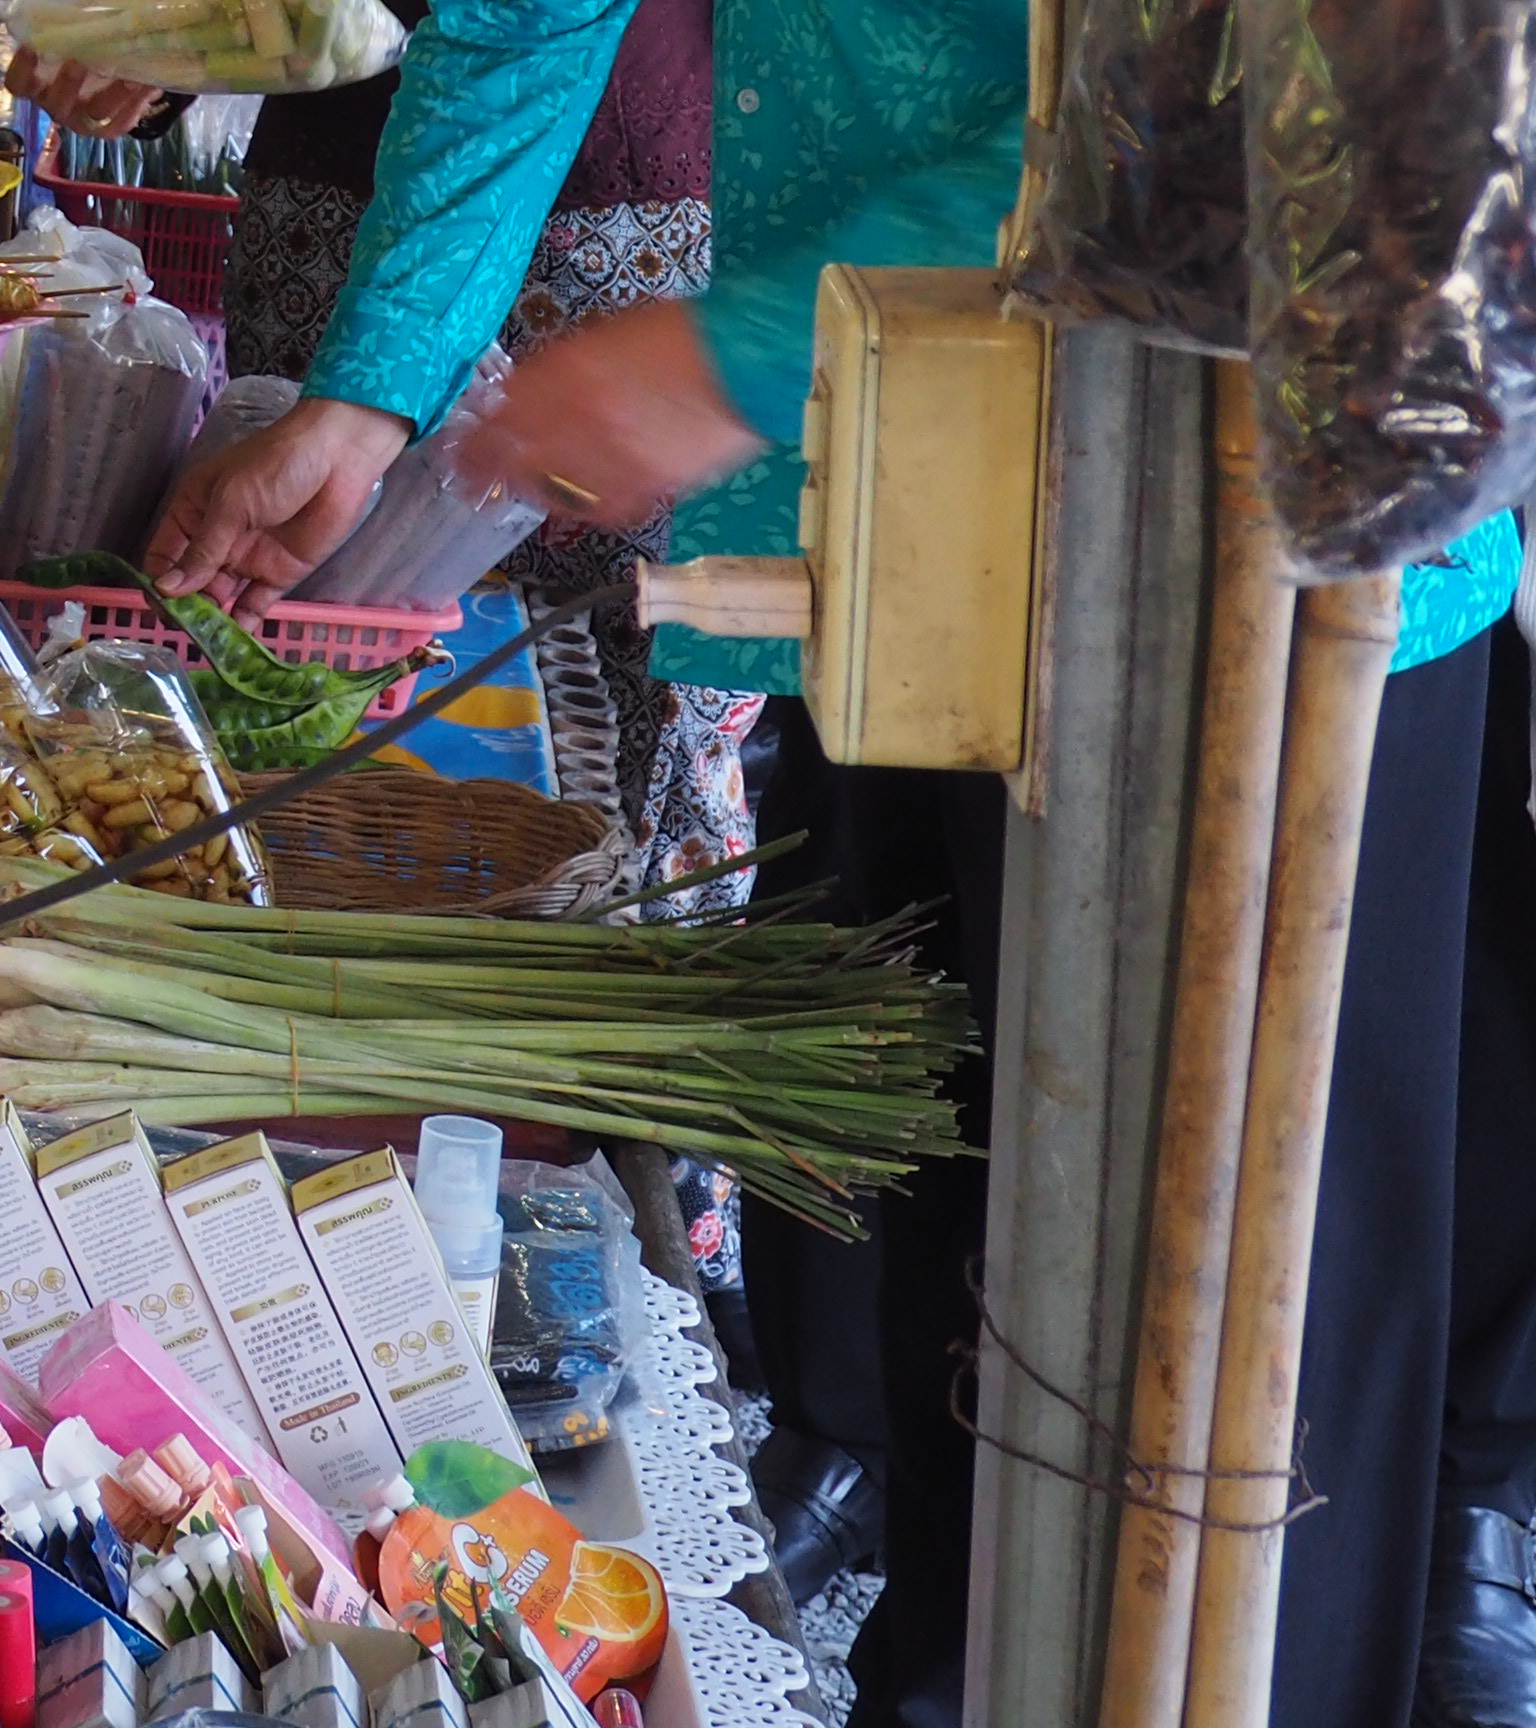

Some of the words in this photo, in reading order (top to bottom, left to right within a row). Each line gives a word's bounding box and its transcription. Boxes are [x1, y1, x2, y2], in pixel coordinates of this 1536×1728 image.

[71, 1168, 113, 1192] สรรพคุณ
[330, 1205, 374, 1229] สรรพคุณ
[6, 1317, 66, 1348] INGREDIENTS
[162, 1333, 193, 1351] DIENTS
[395, 1371, 453, 1400] INGREDIENTS
[282, 1411, 307, 1427] Made
[307, 1407, 320, 1419] in
[318, 1391, 357, 1416] Thailand
[507, 1548, 551, 1607] SERUM
